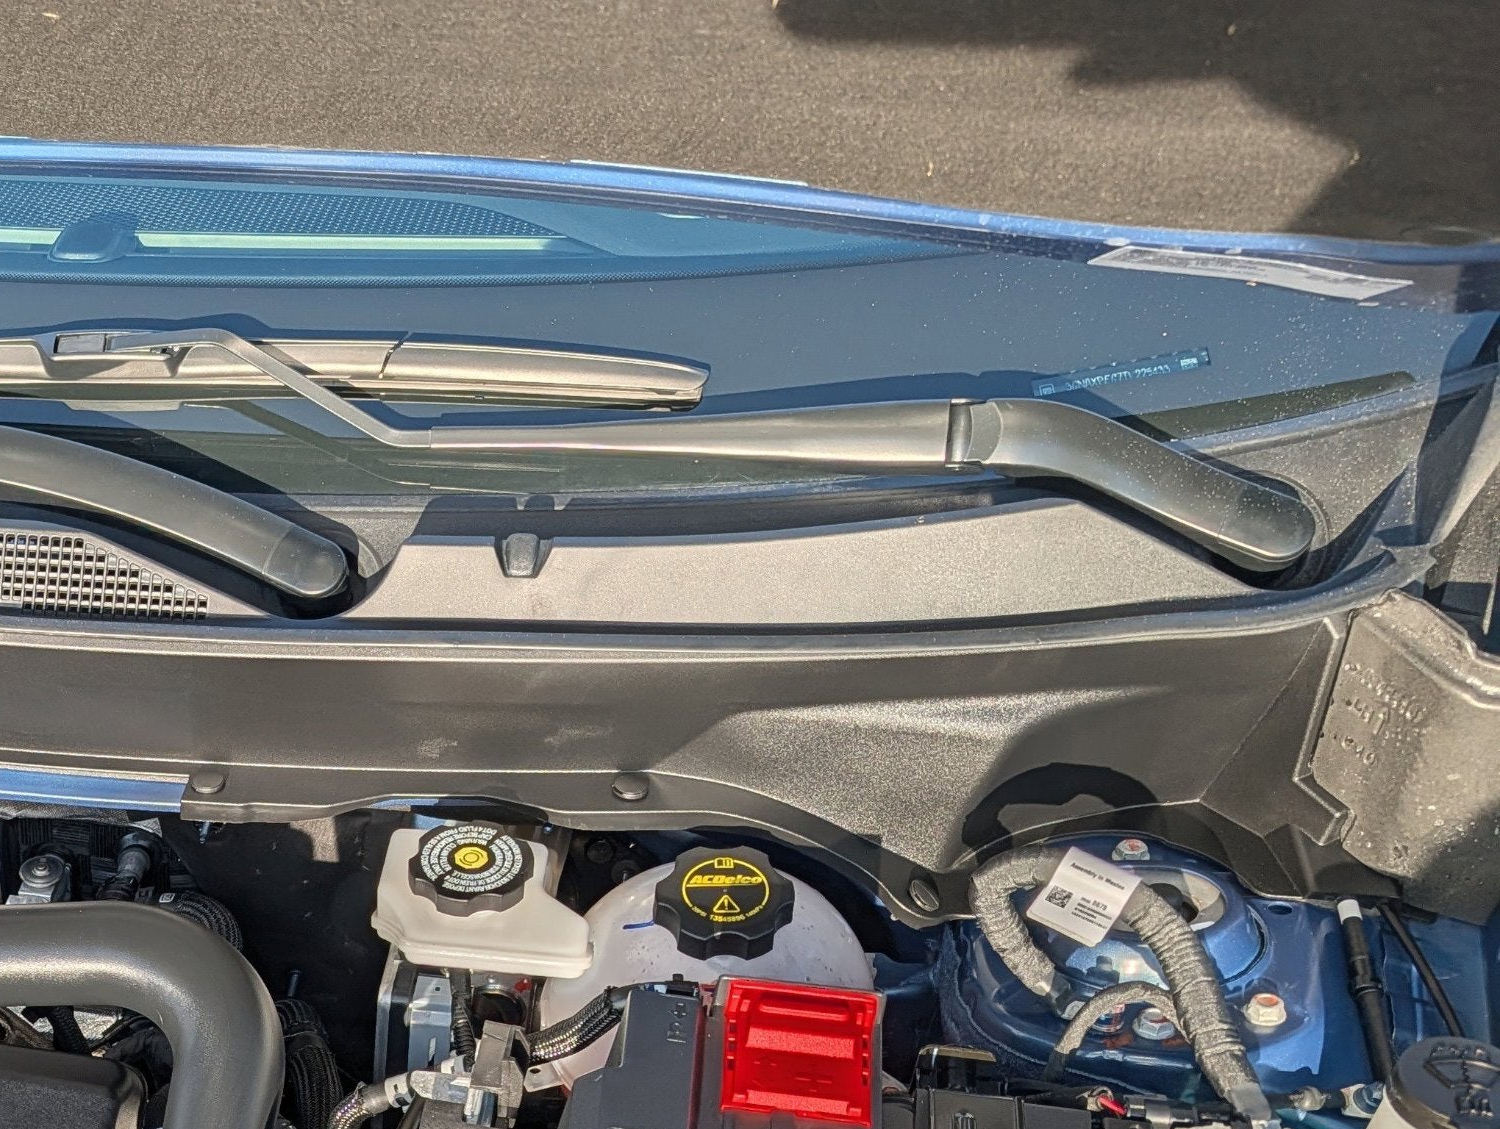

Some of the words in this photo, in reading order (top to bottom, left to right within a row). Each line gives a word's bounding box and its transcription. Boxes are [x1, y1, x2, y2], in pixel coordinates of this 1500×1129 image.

[439, 828, 458, 839] FROM
[458, 825, 478, 833] FLUID
[482, 827, 497, 836] DOT
[688, 874, 762, 885] ACDelco
